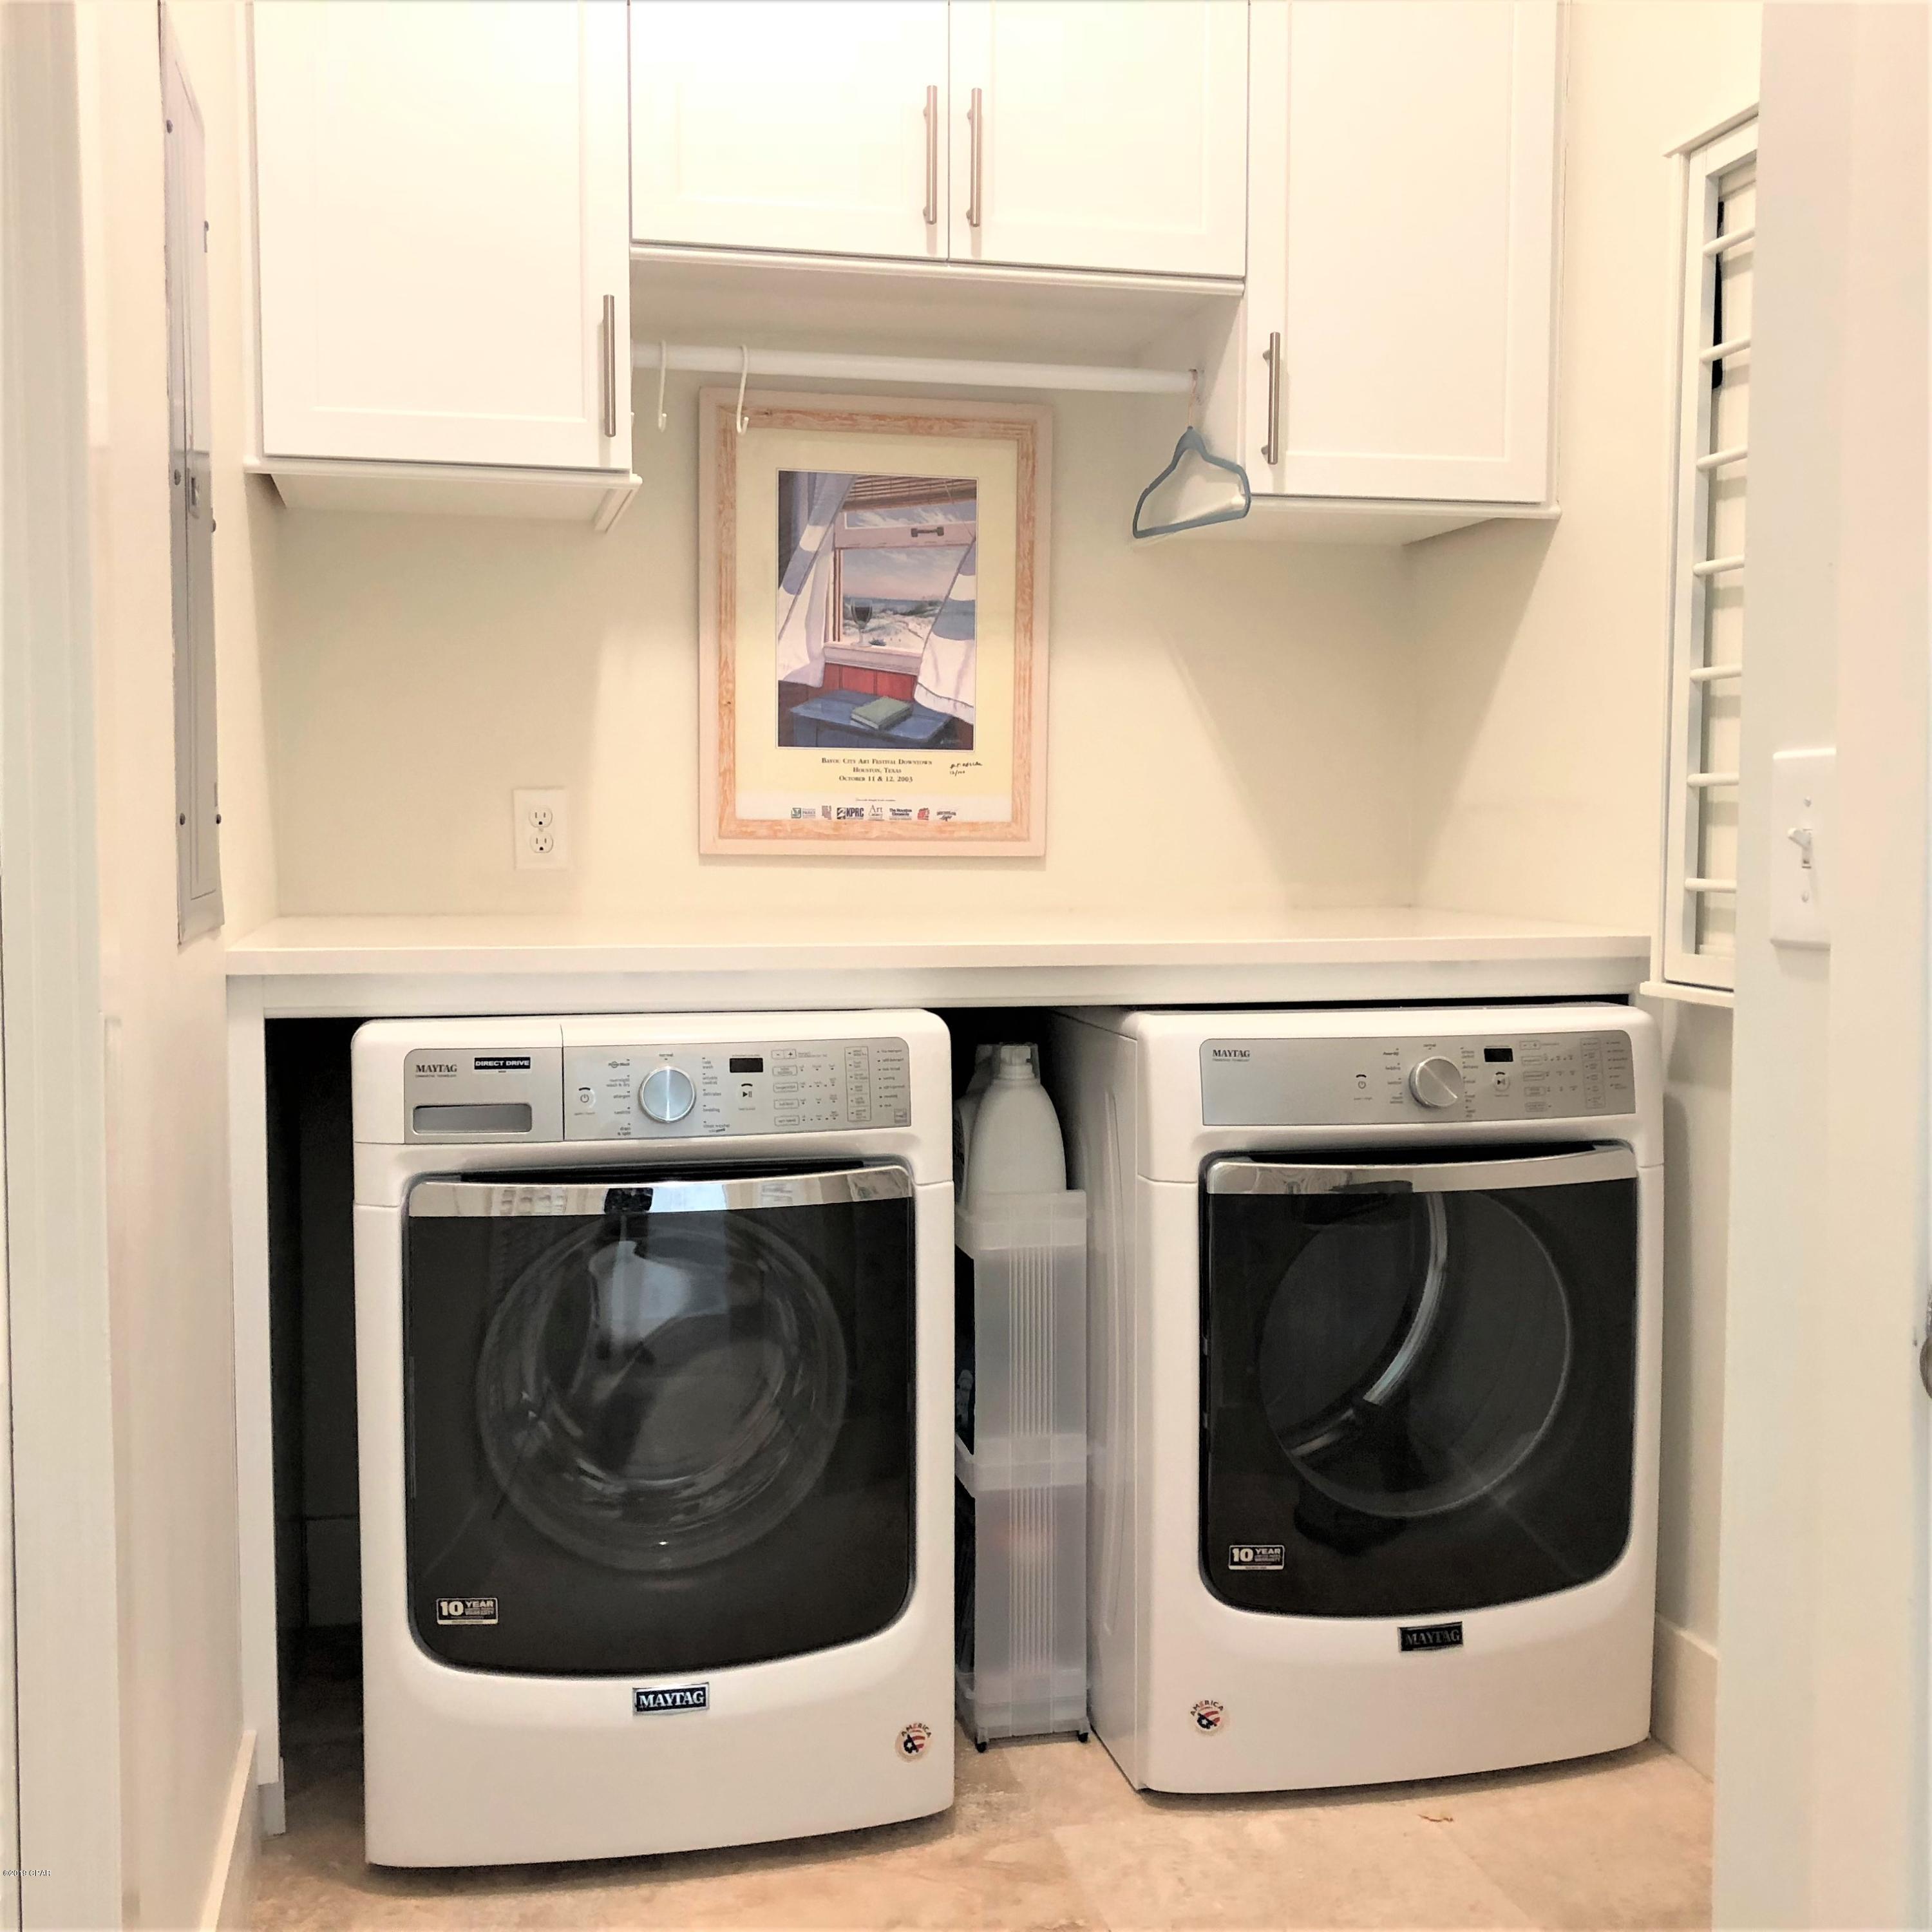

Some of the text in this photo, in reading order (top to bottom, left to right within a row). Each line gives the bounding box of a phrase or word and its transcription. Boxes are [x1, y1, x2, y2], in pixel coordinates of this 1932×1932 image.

[846, 807, 864, 817] KPRC
[1212, 1049, 1251, 1058] MAYTAG
[415, 1064, 457, 1073] MAYTAG
[1232, 1548, 1254, 1562] 10
[440, 1601, 464, 1616] 10
[1405, 1629, 1461, 1645] MAYTAG
[639, 1690, 705, 1709] MAYTAG
[1190, 1700, 1224, 1716] AMERICA
[902, 1723, 932, 1738] AMERICA
